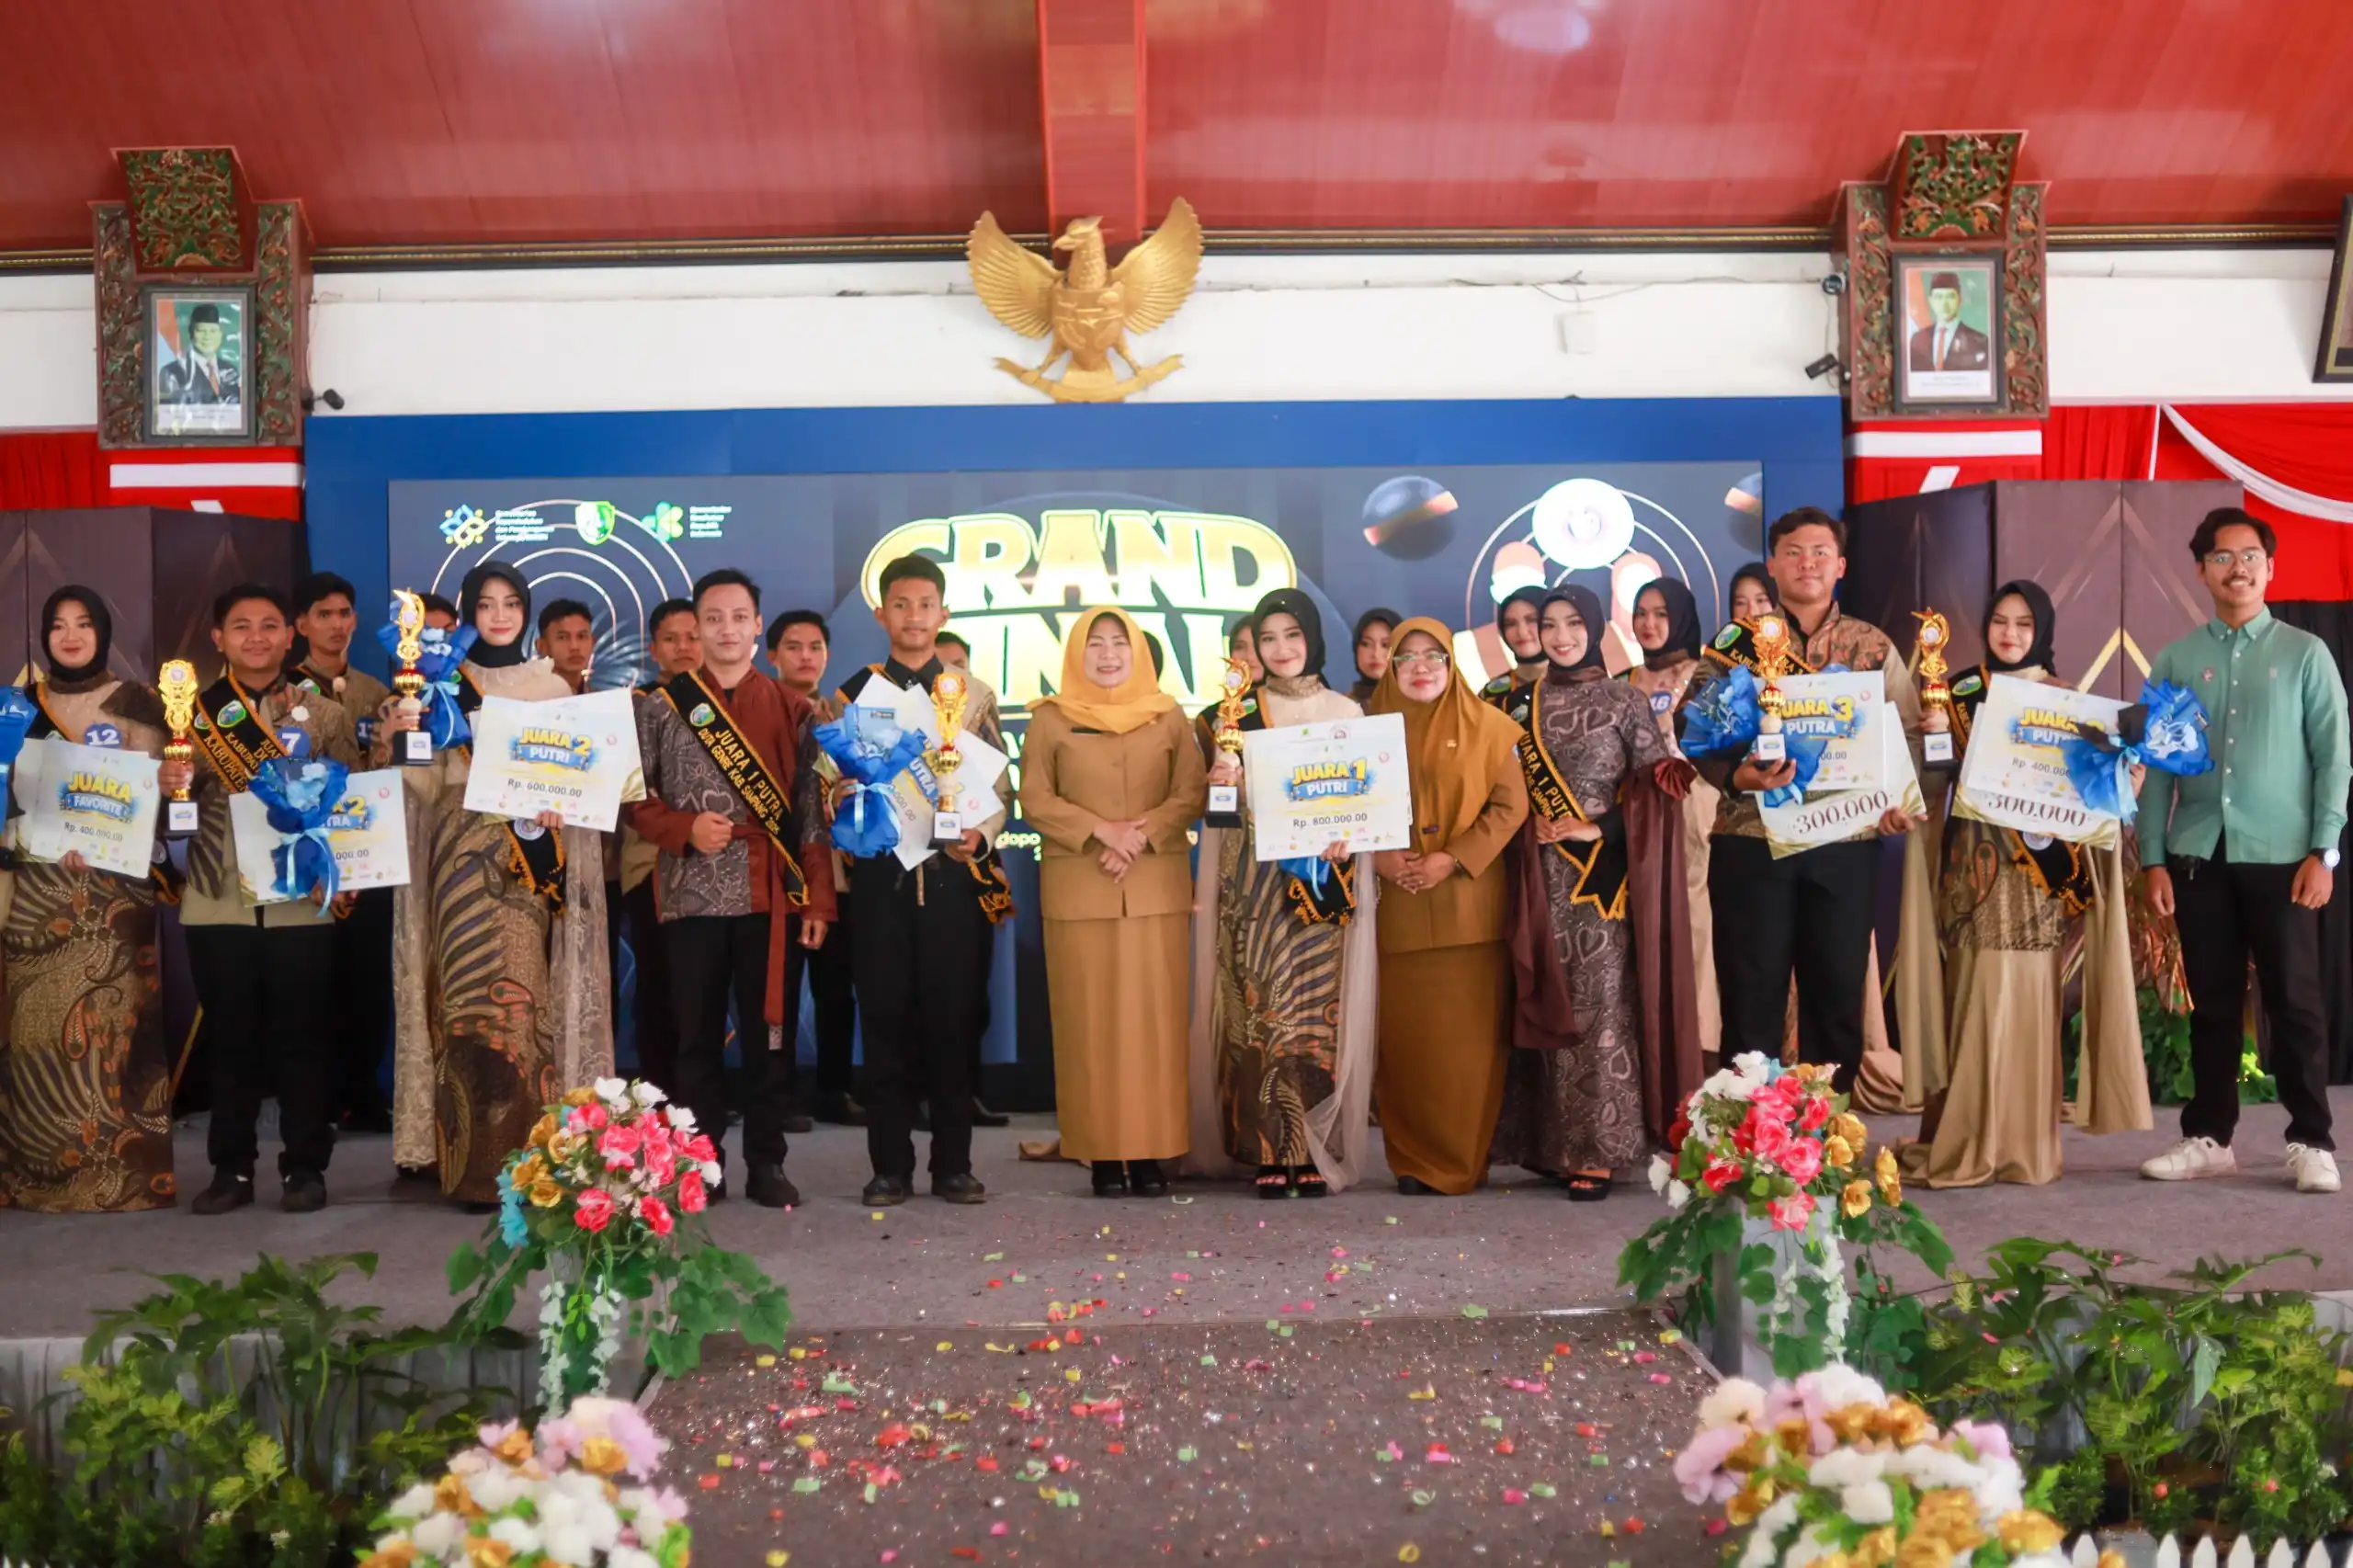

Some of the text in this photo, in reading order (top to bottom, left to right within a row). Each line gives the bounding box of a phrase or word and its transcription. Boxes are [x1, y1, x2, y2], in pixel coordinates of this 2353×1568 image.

[861, 510, 1297, 613] GRAND
[1782, 696, 1855, 722] UARA 3
[86, 729, 119, 746] 12
[1786, 720, 1837, 734] PUTRA
[224, 732, 258, 770] KABUPAT
[281, 733, 301, 754] 7
[519, 727, 593, 757] JUARA 2
[529, 746, 571, 764] PUTRI
[1518, 733, 1541, 774] UARA
[1538, 777, 1550, 787] 1
[715, 730, 783, 821] JUARA 1 PUTRA
[908, 756, 936, 796] UTRA
[1292, 757, 1368, 785] JUARA 1
[67, 771, 132, 802] JUARA
[507, 778, 583, 798] Rp. 600.000.00
[1306, 781, 1348, 796] PUTRI
[74, 795, 123, 816] FAVORITE
[346, 796, 366, 816] 2
[1796, 790, 1888, 835] 300.000
[326, 813, 351, 827] TRA
[1292, 812, 1368, 829] Rp. 800.000.00
[994, 830, 1041, 849] dopo
